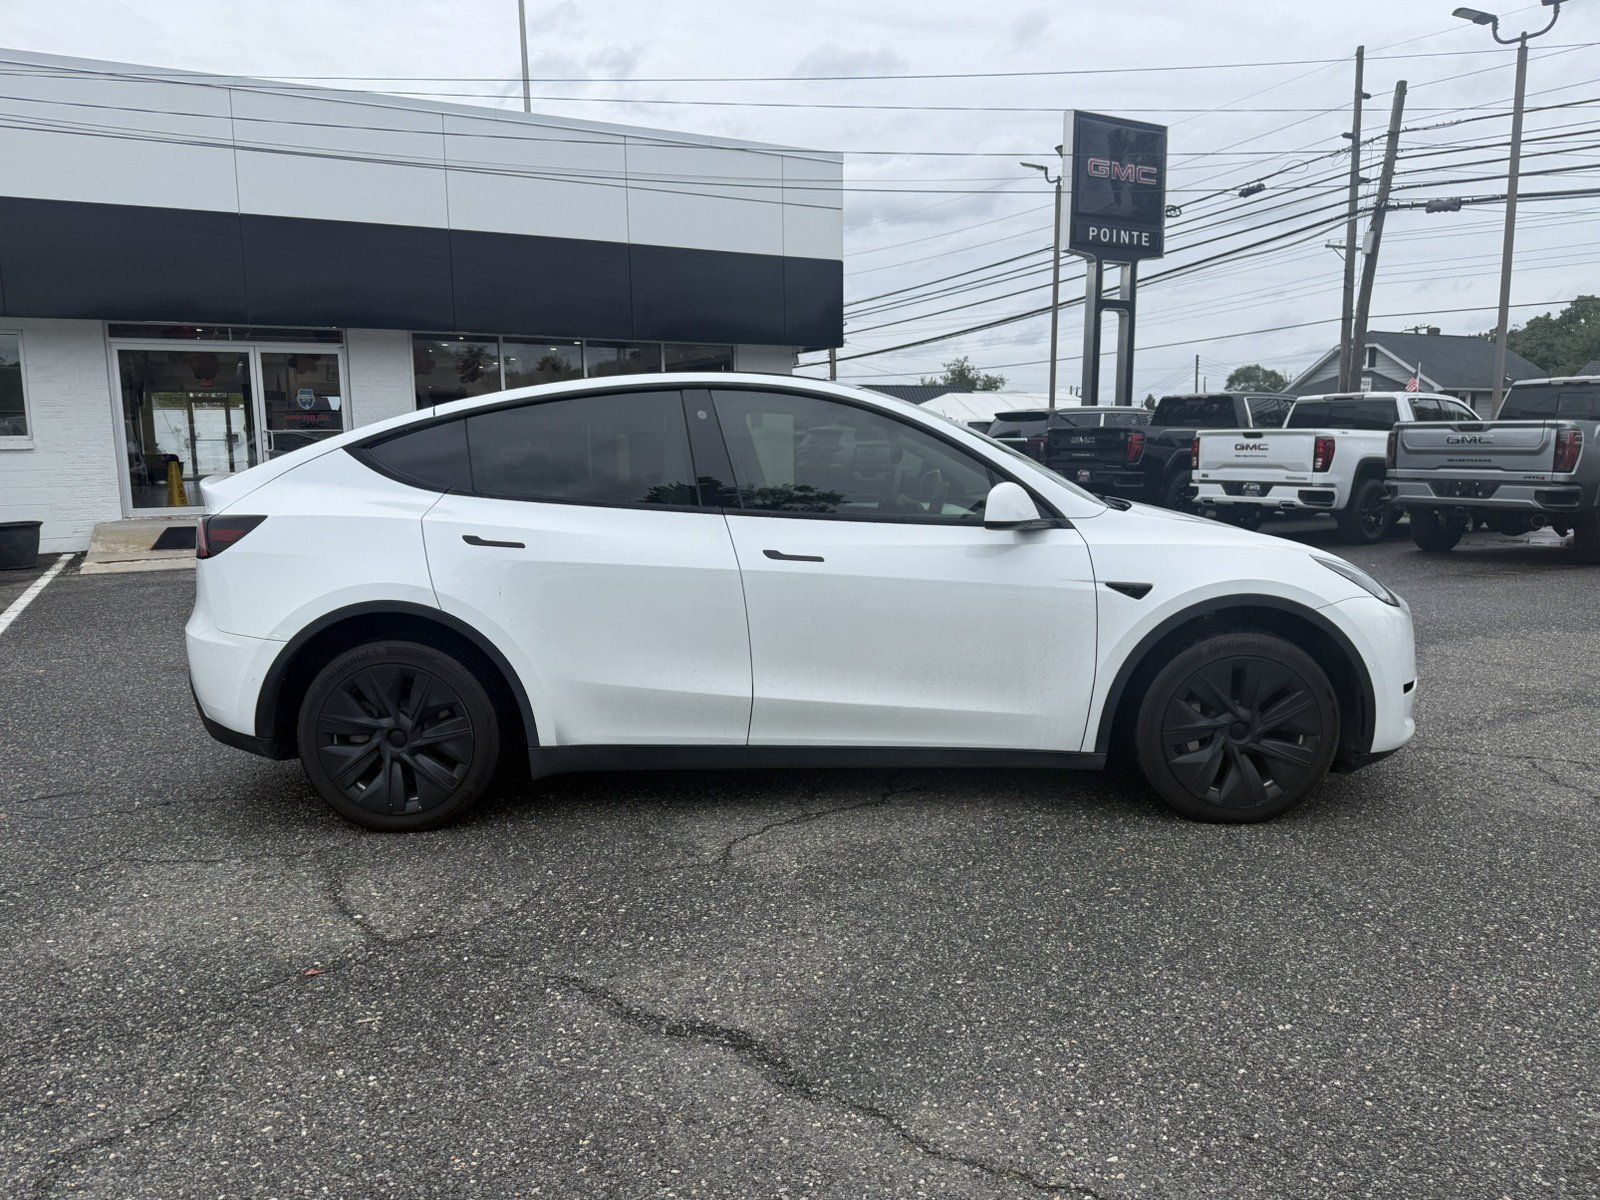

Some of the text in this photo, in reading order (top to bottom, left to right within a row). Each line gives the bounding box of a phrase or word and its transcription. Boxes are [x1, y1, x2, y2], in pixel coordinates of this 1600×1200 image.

[1087, 158, 1158, 185] GMC
[1088, 226, 1151, 246] POINTE
[1234, 443, 1269, 451] GMC
[1446, 434, 1494, 445] GMC
